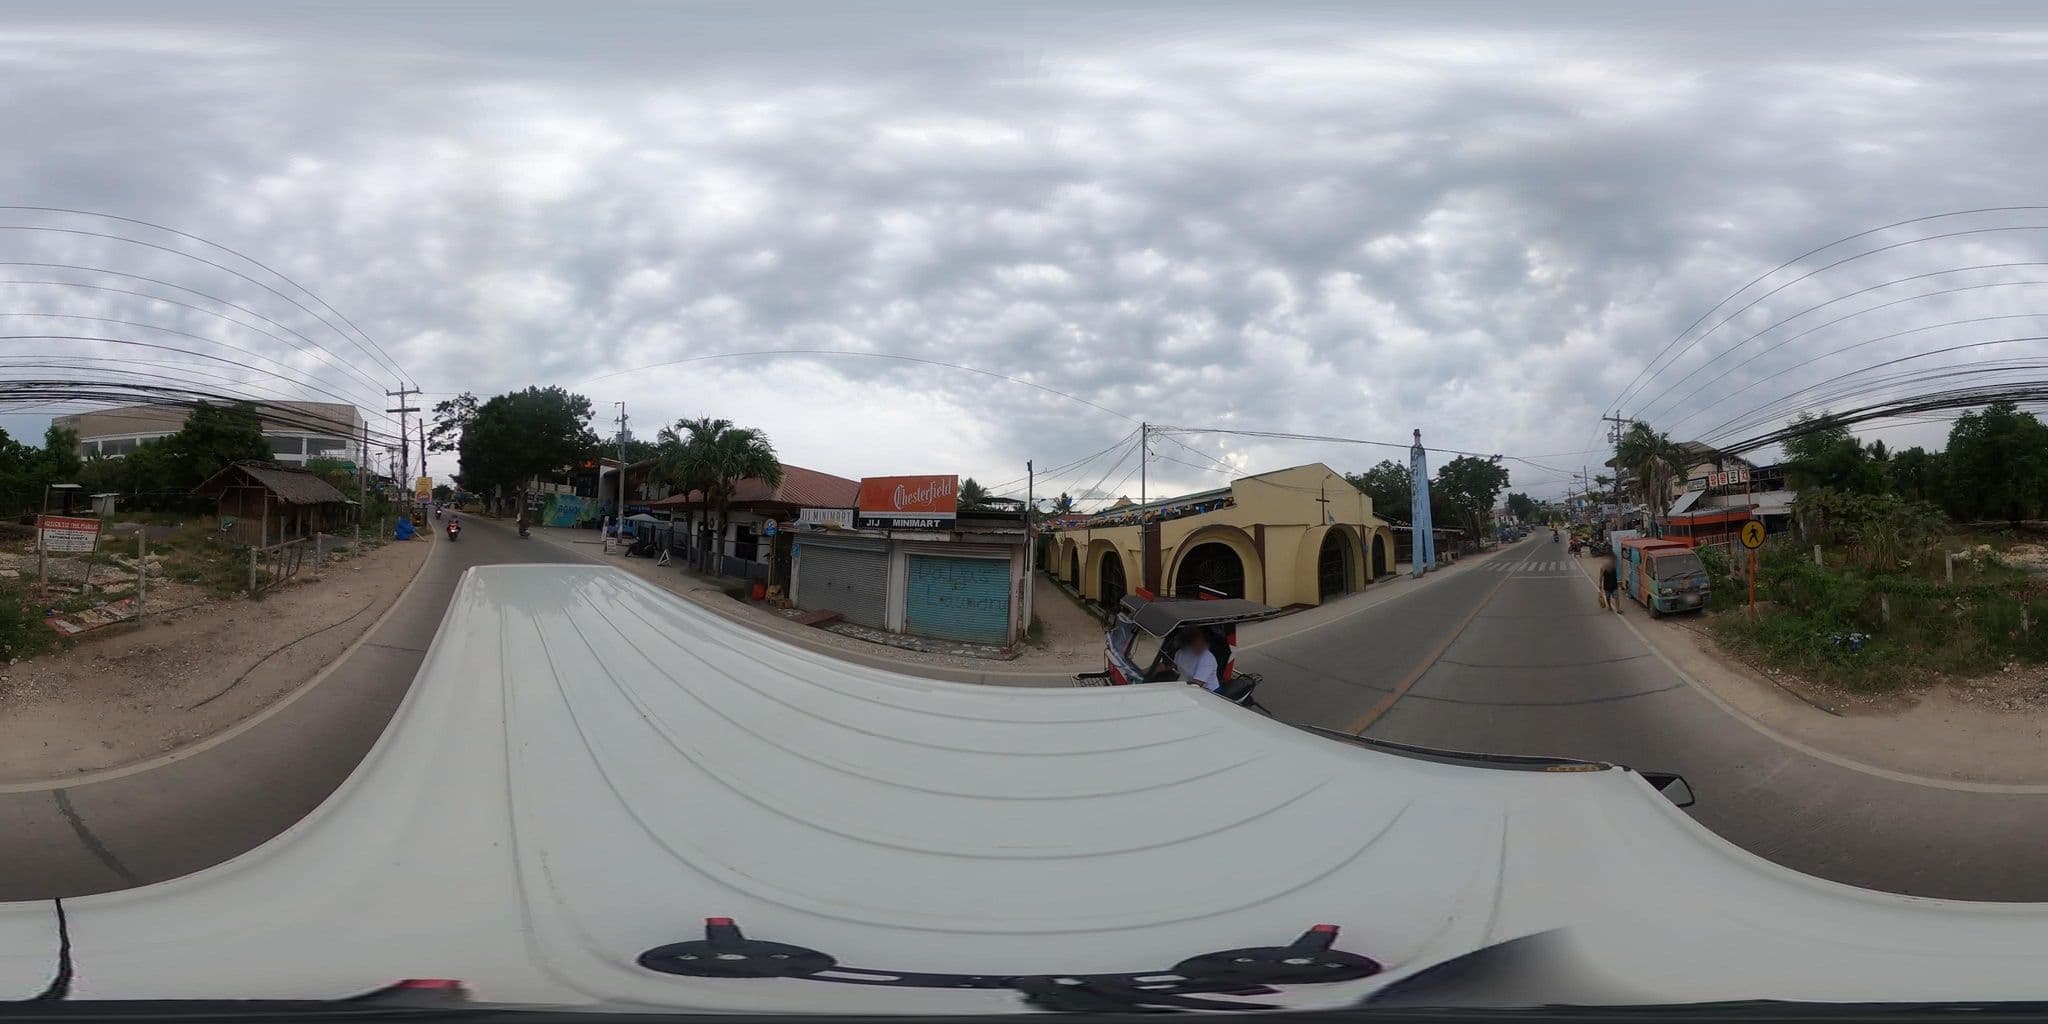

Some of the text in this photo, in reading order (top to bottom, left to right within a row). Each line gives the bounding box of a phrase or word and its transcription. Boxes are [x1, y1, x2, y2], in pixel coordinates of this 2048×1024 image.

[893, 478, 951, 511] Chesterfield
[813, 509, 850, 522] MINIMART
[866, 519, 941, 528] JIJ MINIMART
